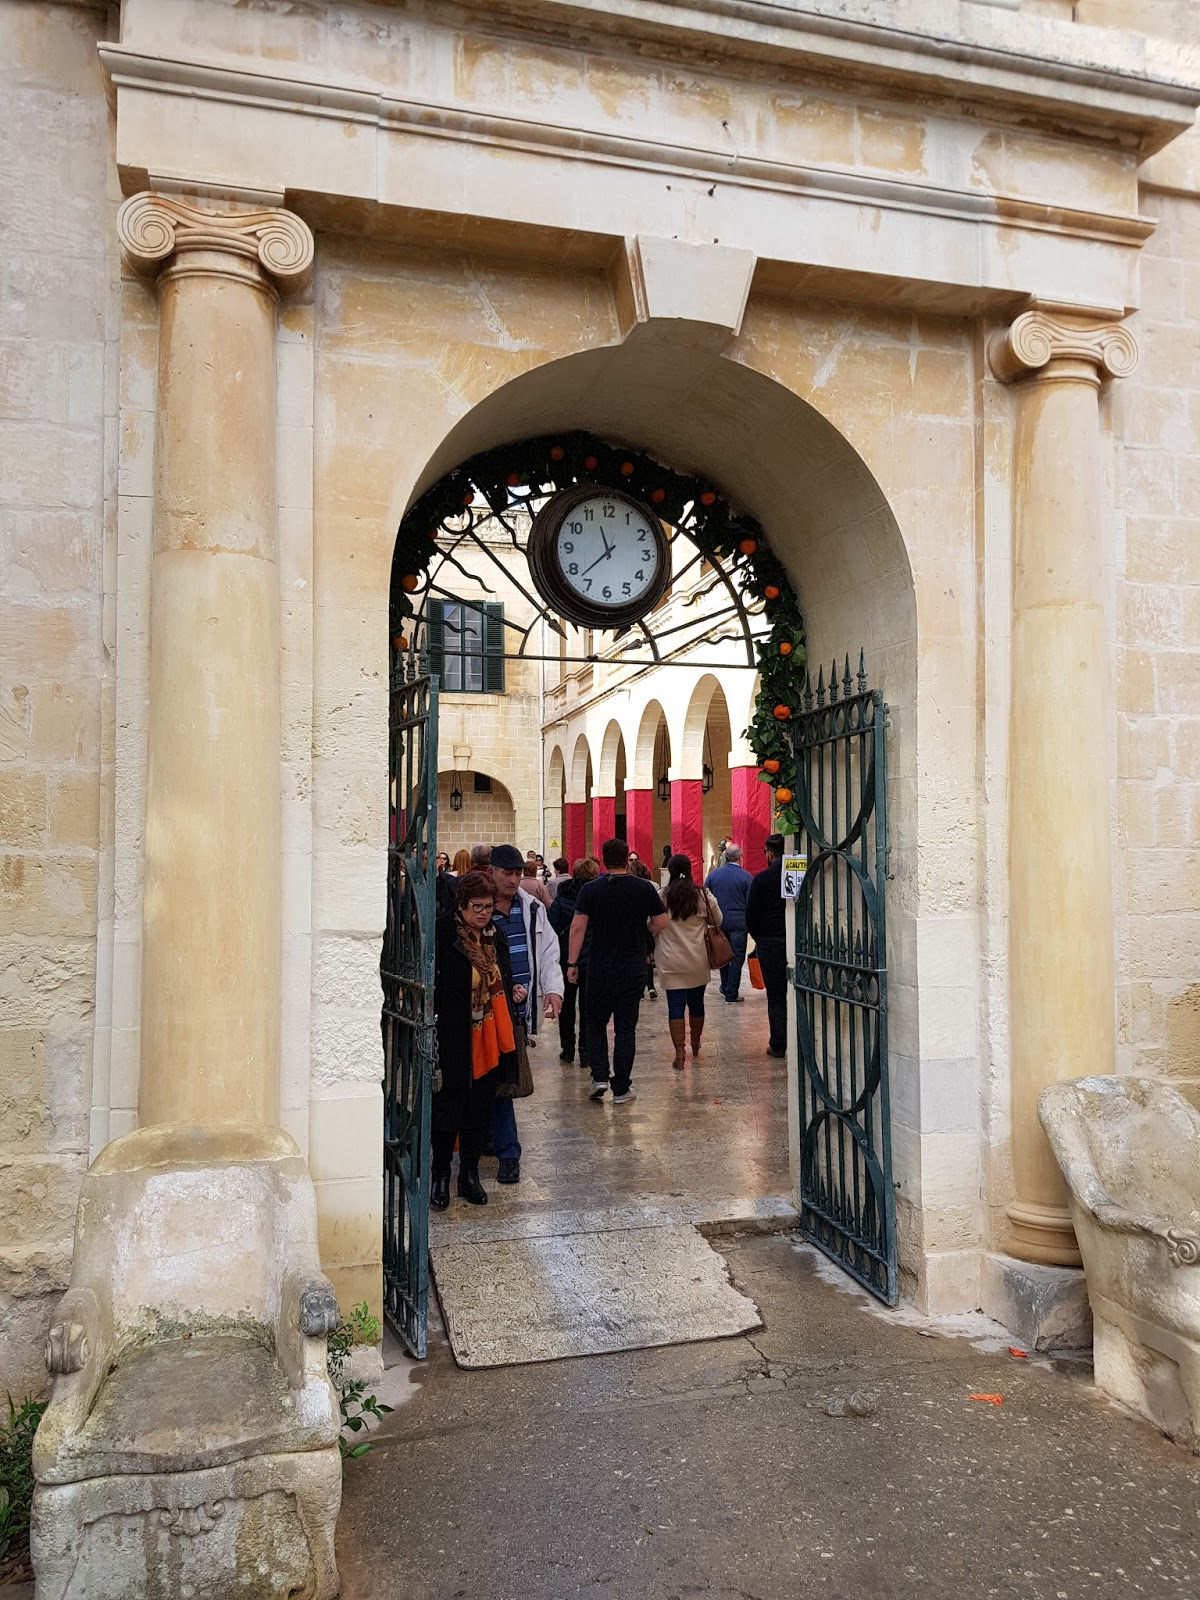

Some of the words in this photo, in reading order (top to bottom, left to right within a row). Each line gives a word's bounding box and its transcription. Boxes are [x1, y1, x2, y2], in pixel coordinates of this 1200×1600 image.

[584, 509, 594, 521] 11
[603, 505, 615, 518] 12
[625, 513, 630, 525] 1
[569, 522, 583, 534] 10
[637, 529, 646, 541] 2
[564, 542, 574, 554] 9
[642, 550, 651, 562] 3
[569, 563, 578, 575] 8
[635, 570, 644, 581] 4
[583, 579, 592, 591] 7
[622, 582, 631, 594] 5
[602, 586, 612, 598] 6
